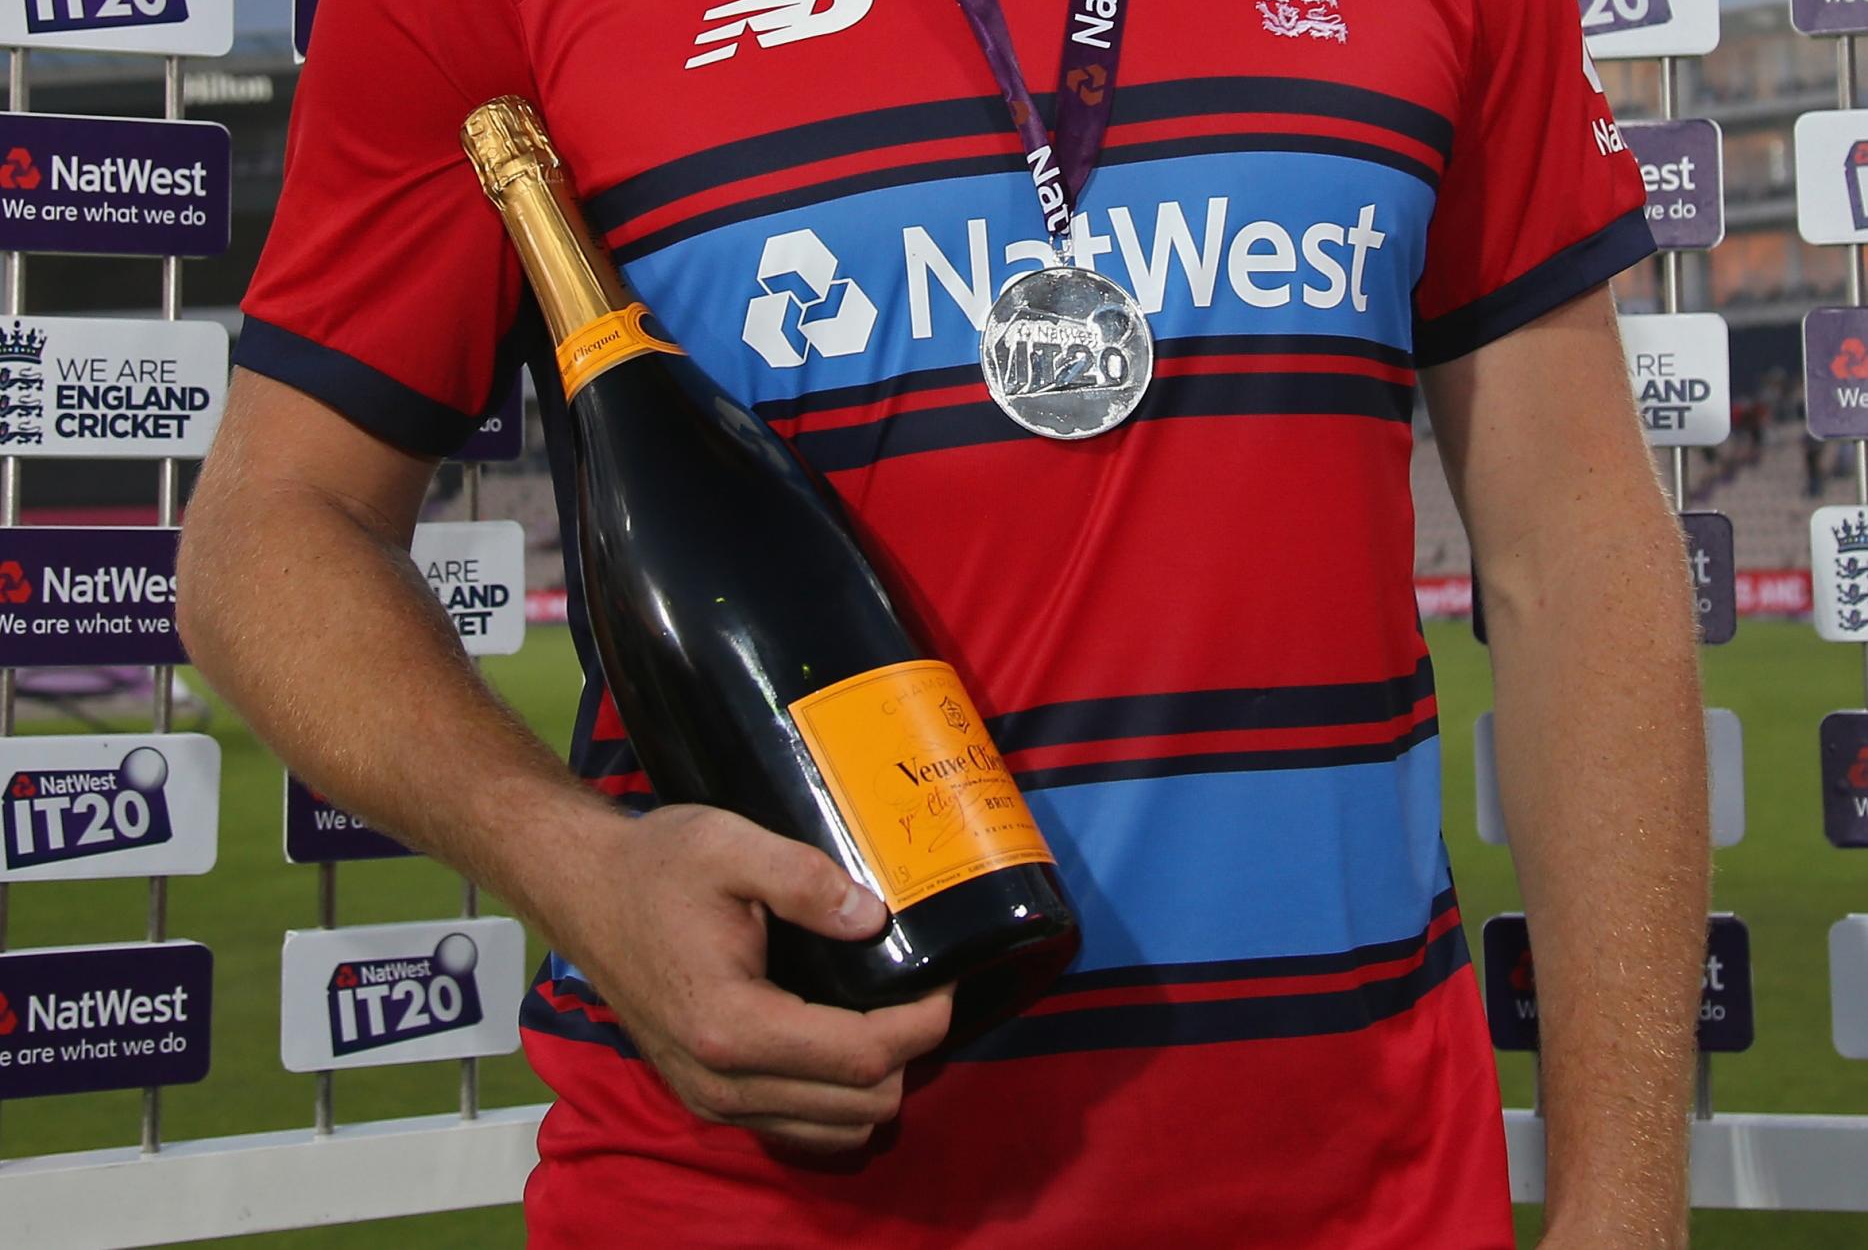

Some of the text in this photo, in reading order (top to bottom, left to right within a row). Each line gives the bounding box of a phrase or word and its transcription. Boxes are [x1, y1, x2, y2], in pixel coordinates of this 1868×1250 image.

[52, 156, 206, 196] NatWest
[3, 199, 205, 225] We are what we do
[1670, 199, 1696, 218] do
[57, 358, 176, 383] WE ARE
[57, 385, 209, 411] ENGLAND
[55, 413, 190, 438] CRICKET
[427, 560, 478, 582] ARE
[43, 567, 177, 603] NatWes
[33, 619, 69, 633] are
[76, 613, 132, 633] what
[138, 619, 169, 632] we
[40, 773, 116, 794] NatWest
[896, 757, 966, 786] Veuve
[985, 797, 1016, 809] BRUT
[14, 790, 149, 854] IT20
[315, 810, 346, 829] We
[361, 961, 431, 984] NatWest
[29, 986, 187, 1032] NatWest
[338, 976, 461, 1042] IT20
[18, 1032, 186, 1064] are what we do
